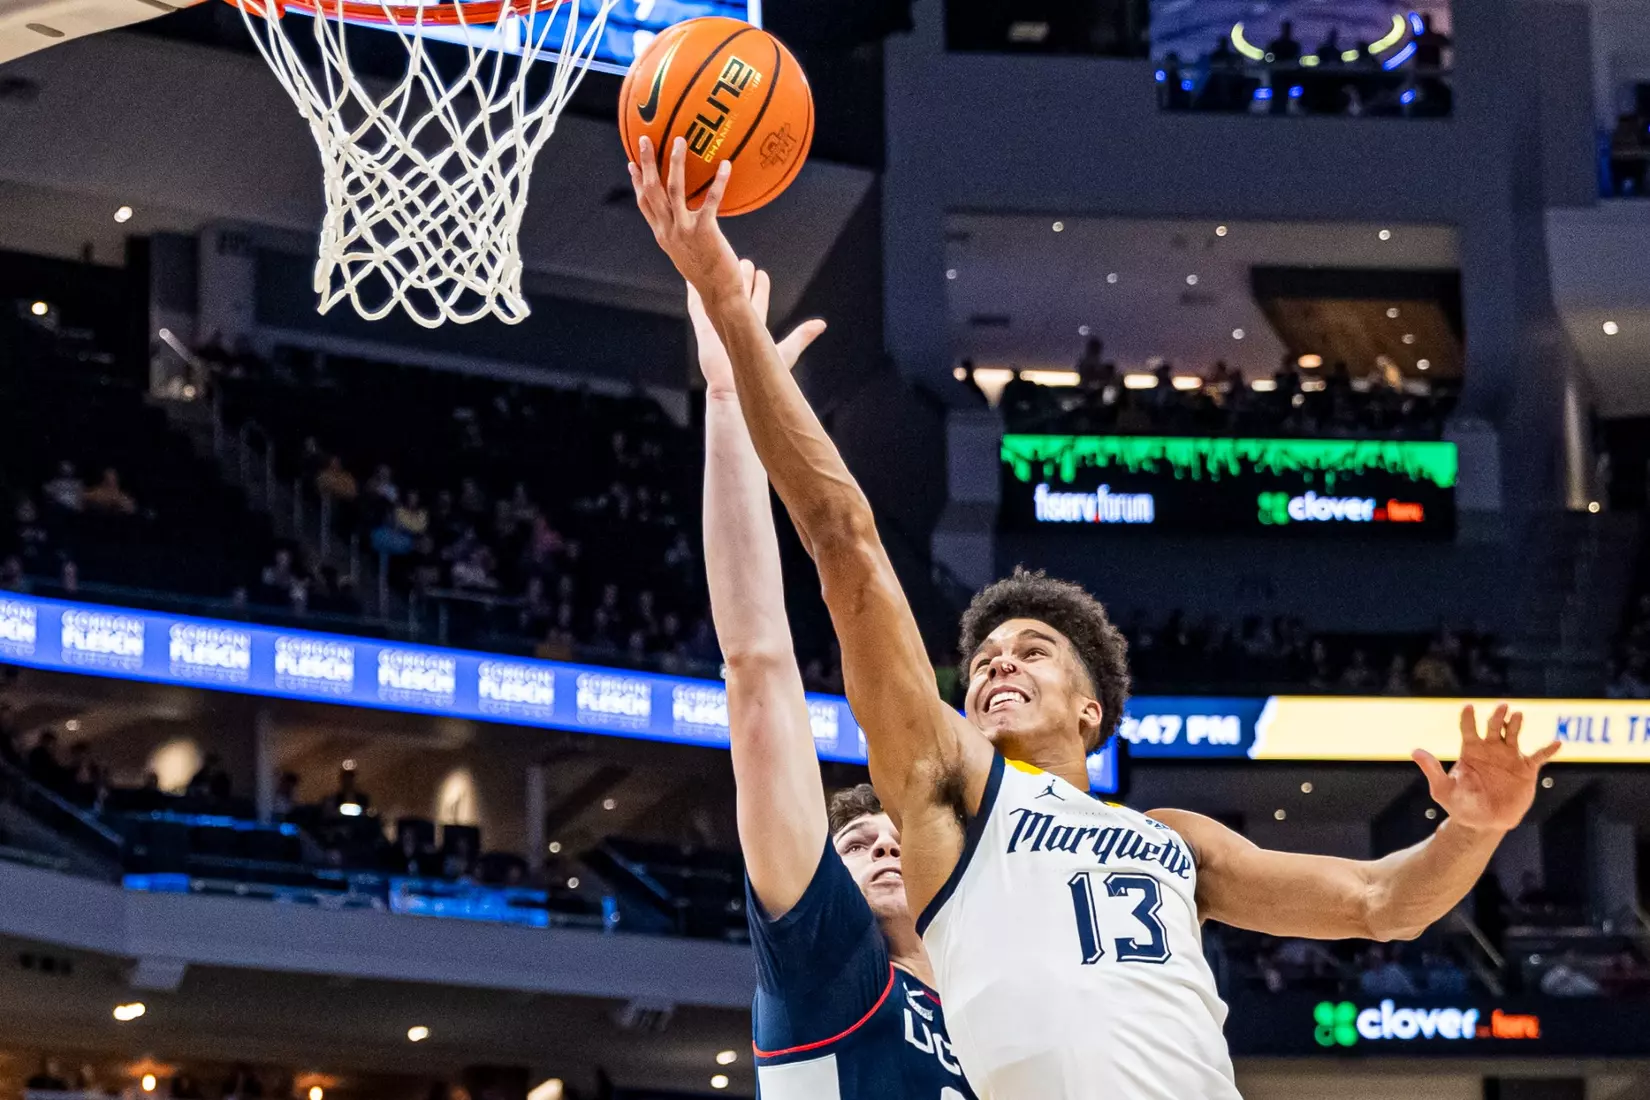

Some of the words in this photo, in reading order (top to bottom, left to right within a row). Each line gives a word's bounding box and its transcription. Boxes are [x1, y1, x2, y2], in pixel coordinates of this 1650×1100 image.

[684, 55, 757, 158] ELITE
[1288, 490, 1376, 522] clover
[1186, 715, 1240, 745] PM
[1556, 716, 1609, 743] KILL
[1007, 808, 1191, 879] Marquette
[1067, 872, 1172, 965] 13
[1356, 999, 1479, 1039] clover
